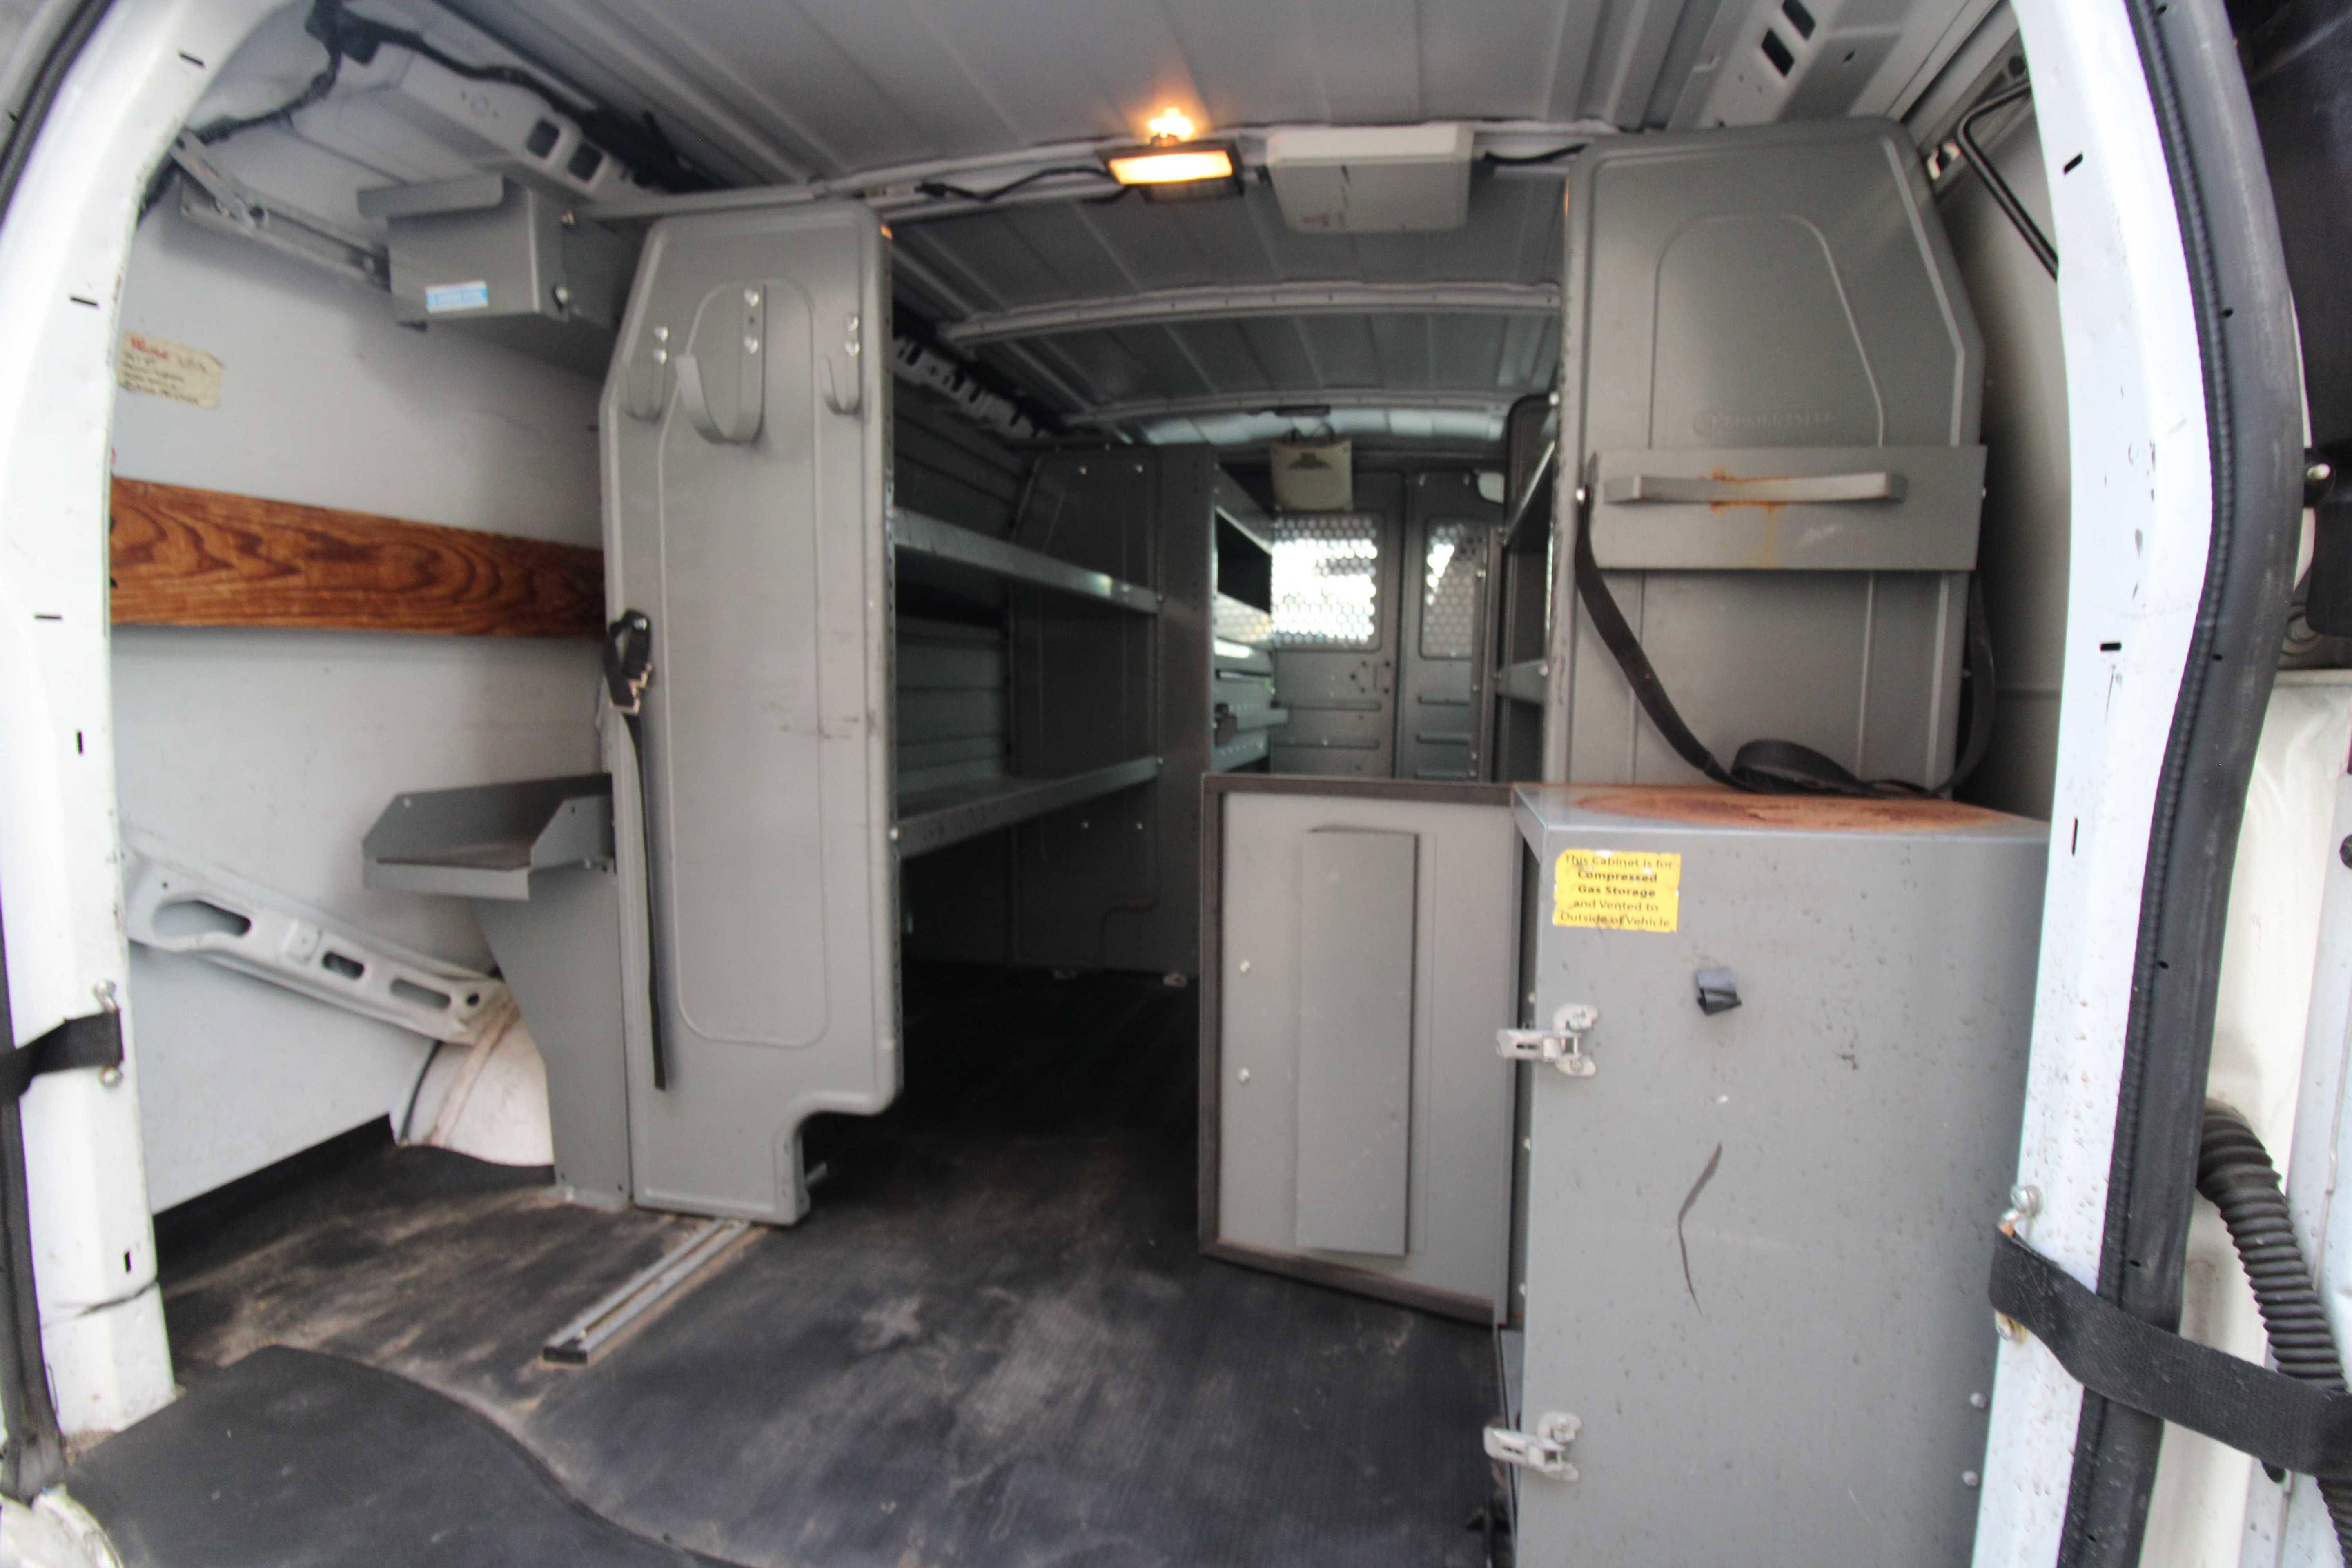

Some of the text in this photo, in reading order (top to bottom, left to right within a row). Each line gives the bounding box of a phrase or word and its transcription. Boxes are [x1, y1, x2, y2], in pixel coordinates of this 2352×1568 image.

[1566, 854, 1673, 869] This Cabinet is for
[1577, 870, 1657, 882] Compressed
[1578, 884, 1655, 898] Gas Storage
[1573, 900, 1659, 911] and Vented to
[1560, 911, 1670, 927] Outside of Vehicle
